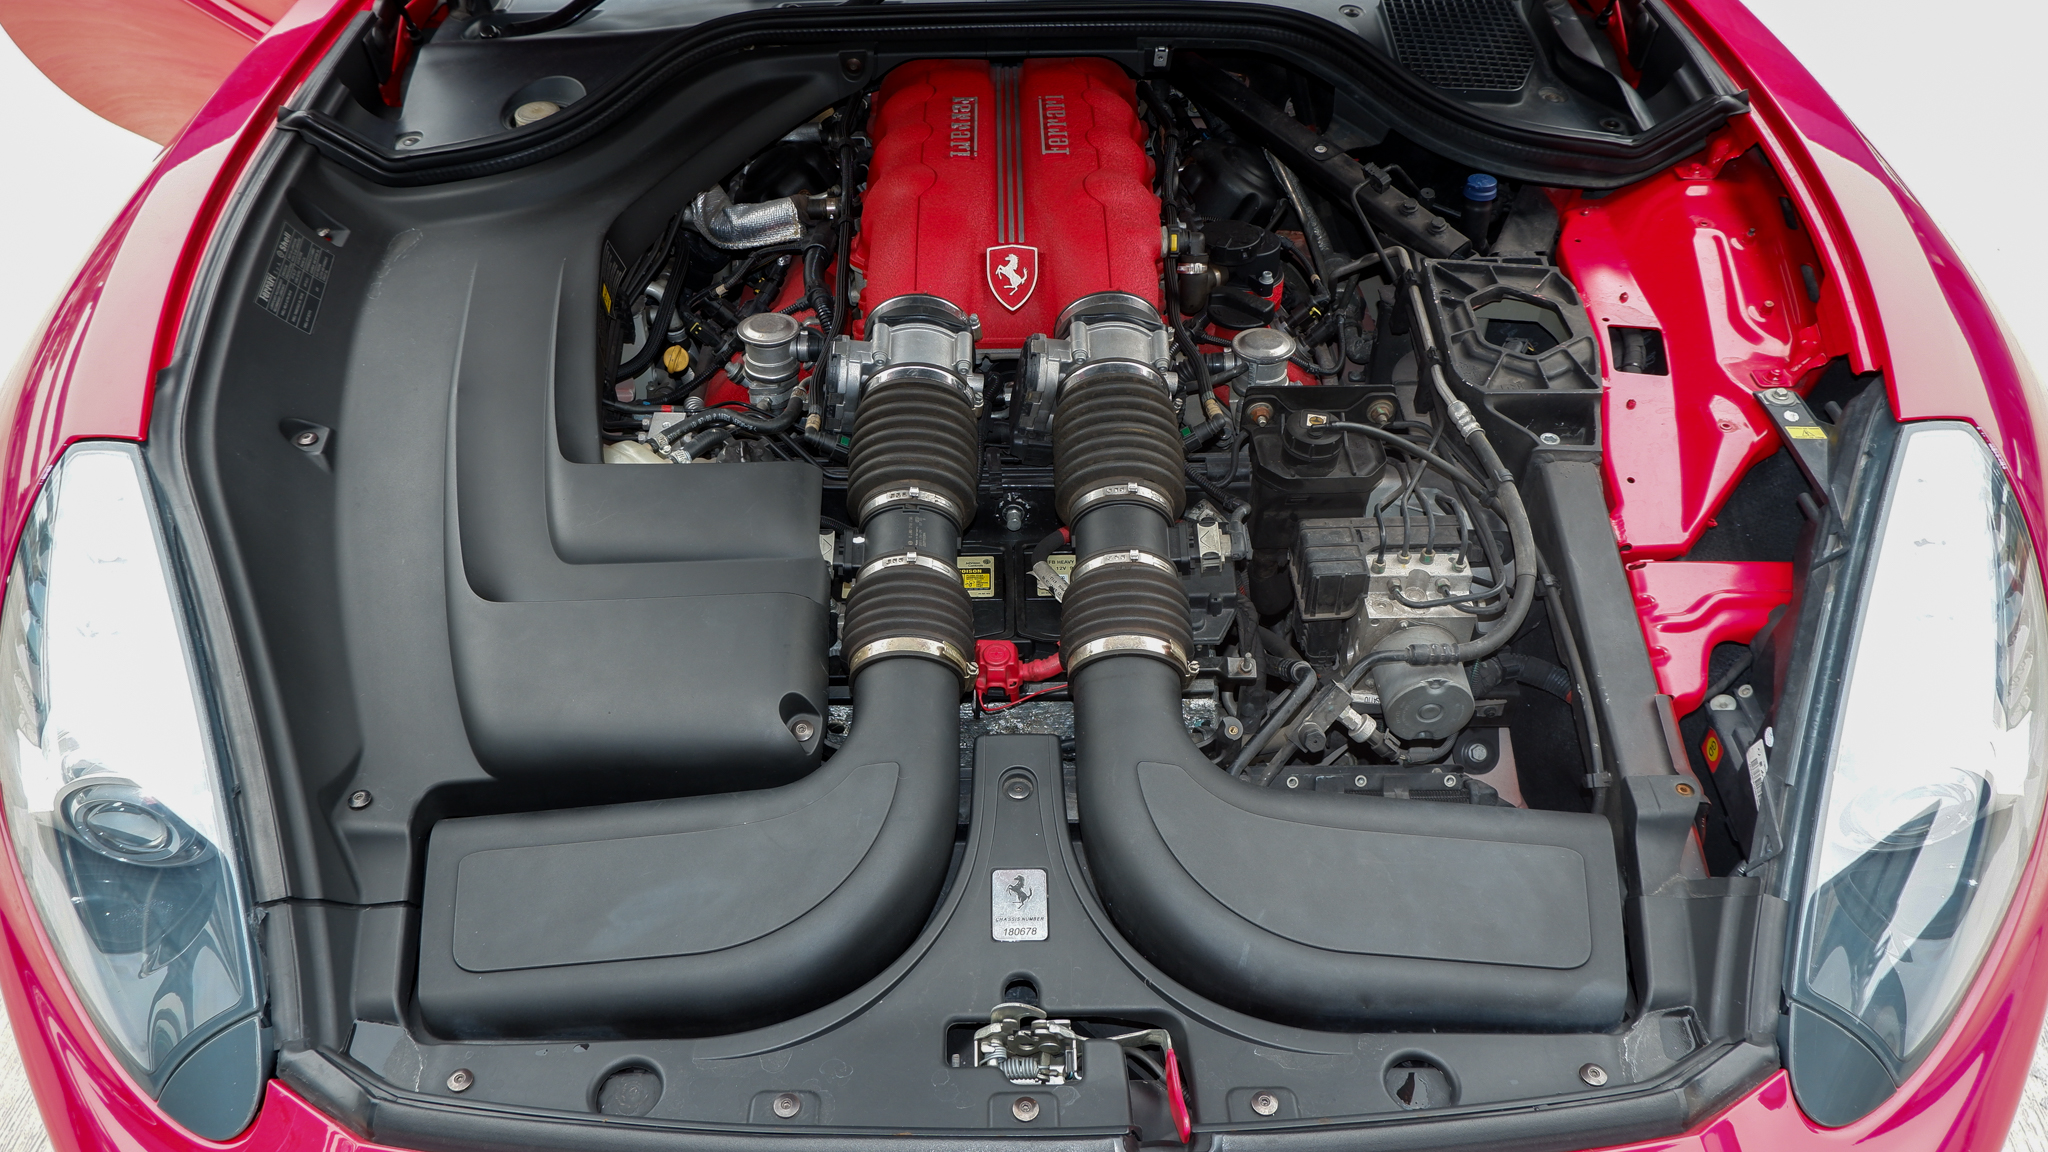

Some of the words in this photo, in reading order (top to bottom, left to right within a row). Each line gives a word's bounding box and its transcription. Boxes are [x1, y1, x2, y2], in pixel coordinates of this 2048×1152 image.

[950, 96, 978, 157] Ferrari
[1038, 95, 1070, 155] Ferrari
[279, 231, 292, 252] Shell
[258, 272, 278, 302] Ferrari
[1004, 927, 1037, 936] 180678
